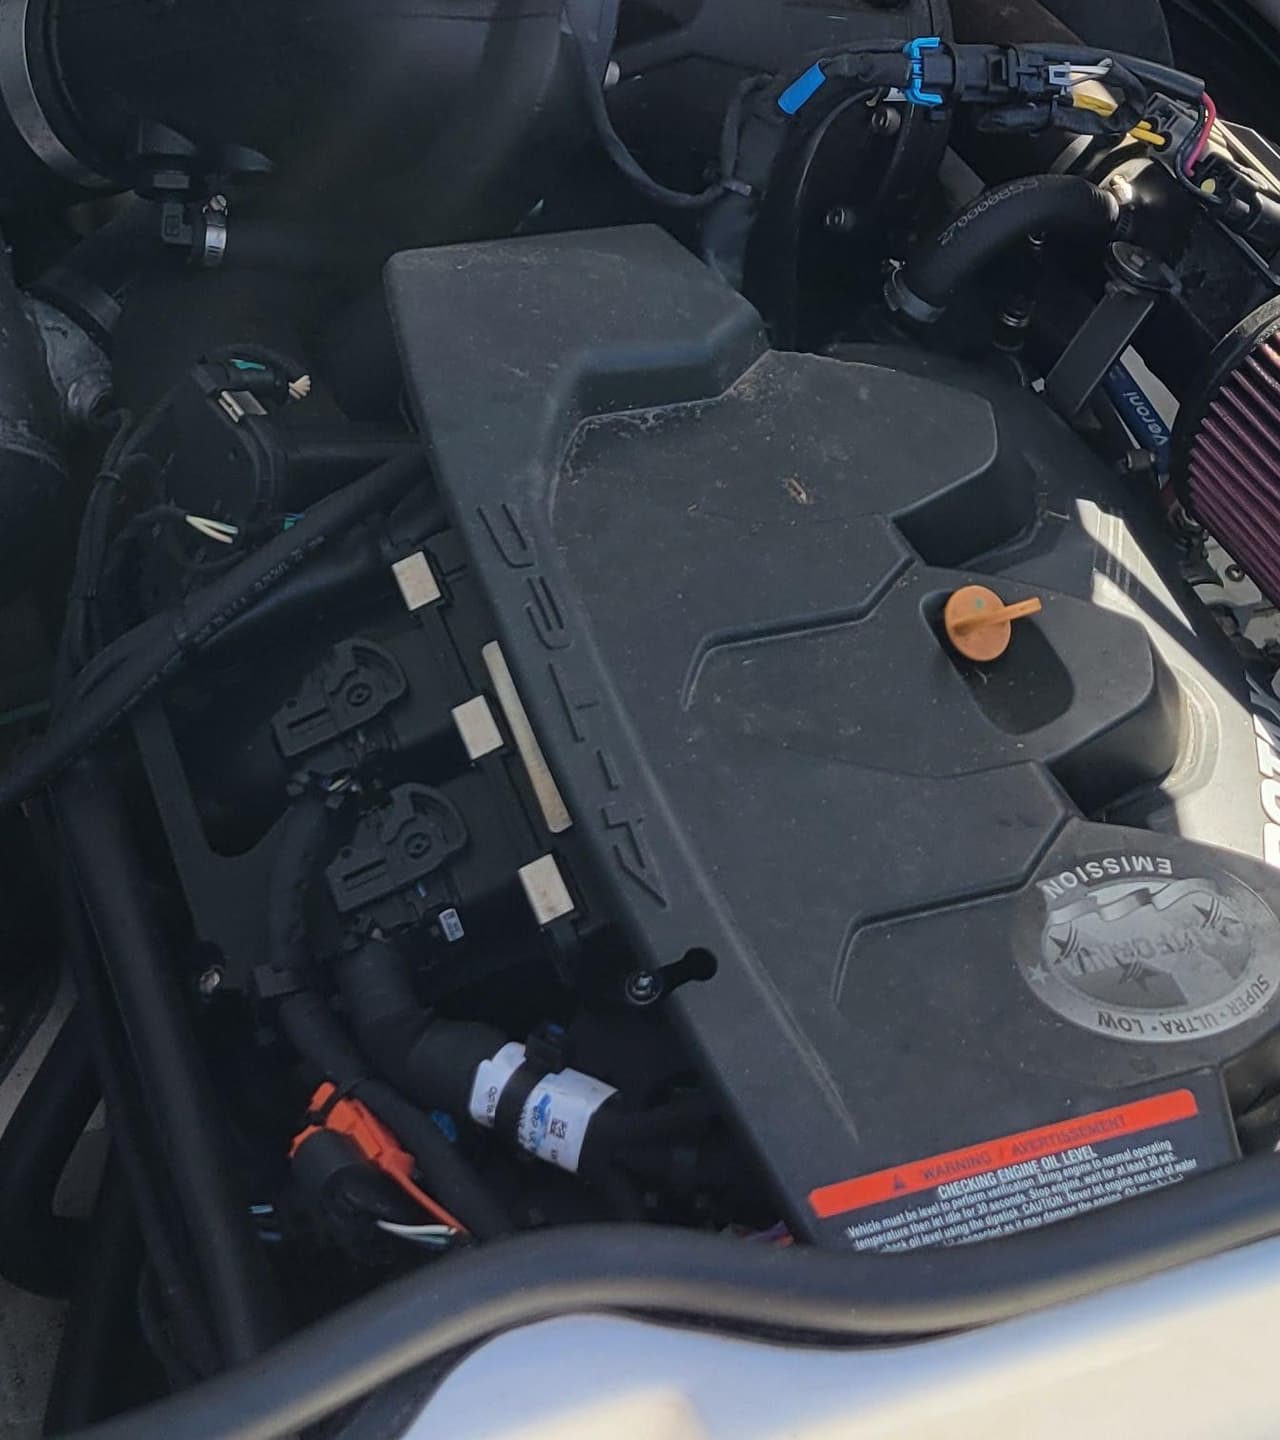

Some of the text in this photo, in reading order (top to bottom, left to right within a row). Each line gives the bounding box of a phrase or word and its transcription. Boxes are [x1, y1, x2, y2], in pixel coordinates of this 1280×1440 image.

[1041, 855, 1174, 900] EMISSION
[1098, 973, 1271, 1036] SUPER ULTRA LOW
[847, 1218, 882, 1238] Vehicle
[881, 1213, 905, 1229] must
[904, 1208, 918, 1221] be
[917, 1201, 941, 1218] level
[940, 1198, 951, 1211] to
[950, 1188, 987, 1210] perform
[1062, 1161, 1092, 1179] engine
[1091, 1157, 1102, 1169] to
[1101, 1148, 1132, 1166] normal
[1131, 1137, 1172, 1160] operating
[922, 1153, 991, 1180] WARNING
[937, 1142, 1097, 1199] CHECKING ENGINE OIL LEVEL
[854, 1225, 910, 1252] temperature
[909, 1219, 931, 1234] then
[930, 1214, 944, 1228] let
[943, 1209, 962, 1224] idle
[961, 1205, 976, 1218] for
[975, 1201, 988, 1214] 30
[1028, 1185, 1052, 1201] Stop
[1101, 1166, 1115, 1179] for
[1115, 1163, 1126, 1175] at
[1125, 1156, 1147, 1172] least
[1146, 1154, 1159, 1167] 30
[908, 1236, 921, 1248] oil
[921, 1229, 943, 1244] level
[943, 1222, 969, 1239] using
[968, 1216, 984, 1230] the
[1091, 1182, 1105, 1195] let
[1104, 1175, 1134, 1193] engine
[1133, 1172, 1149, 1184] run
[1149, 1167, 1164, 1179] out
[1163, 1162, 1175, 1175] of
